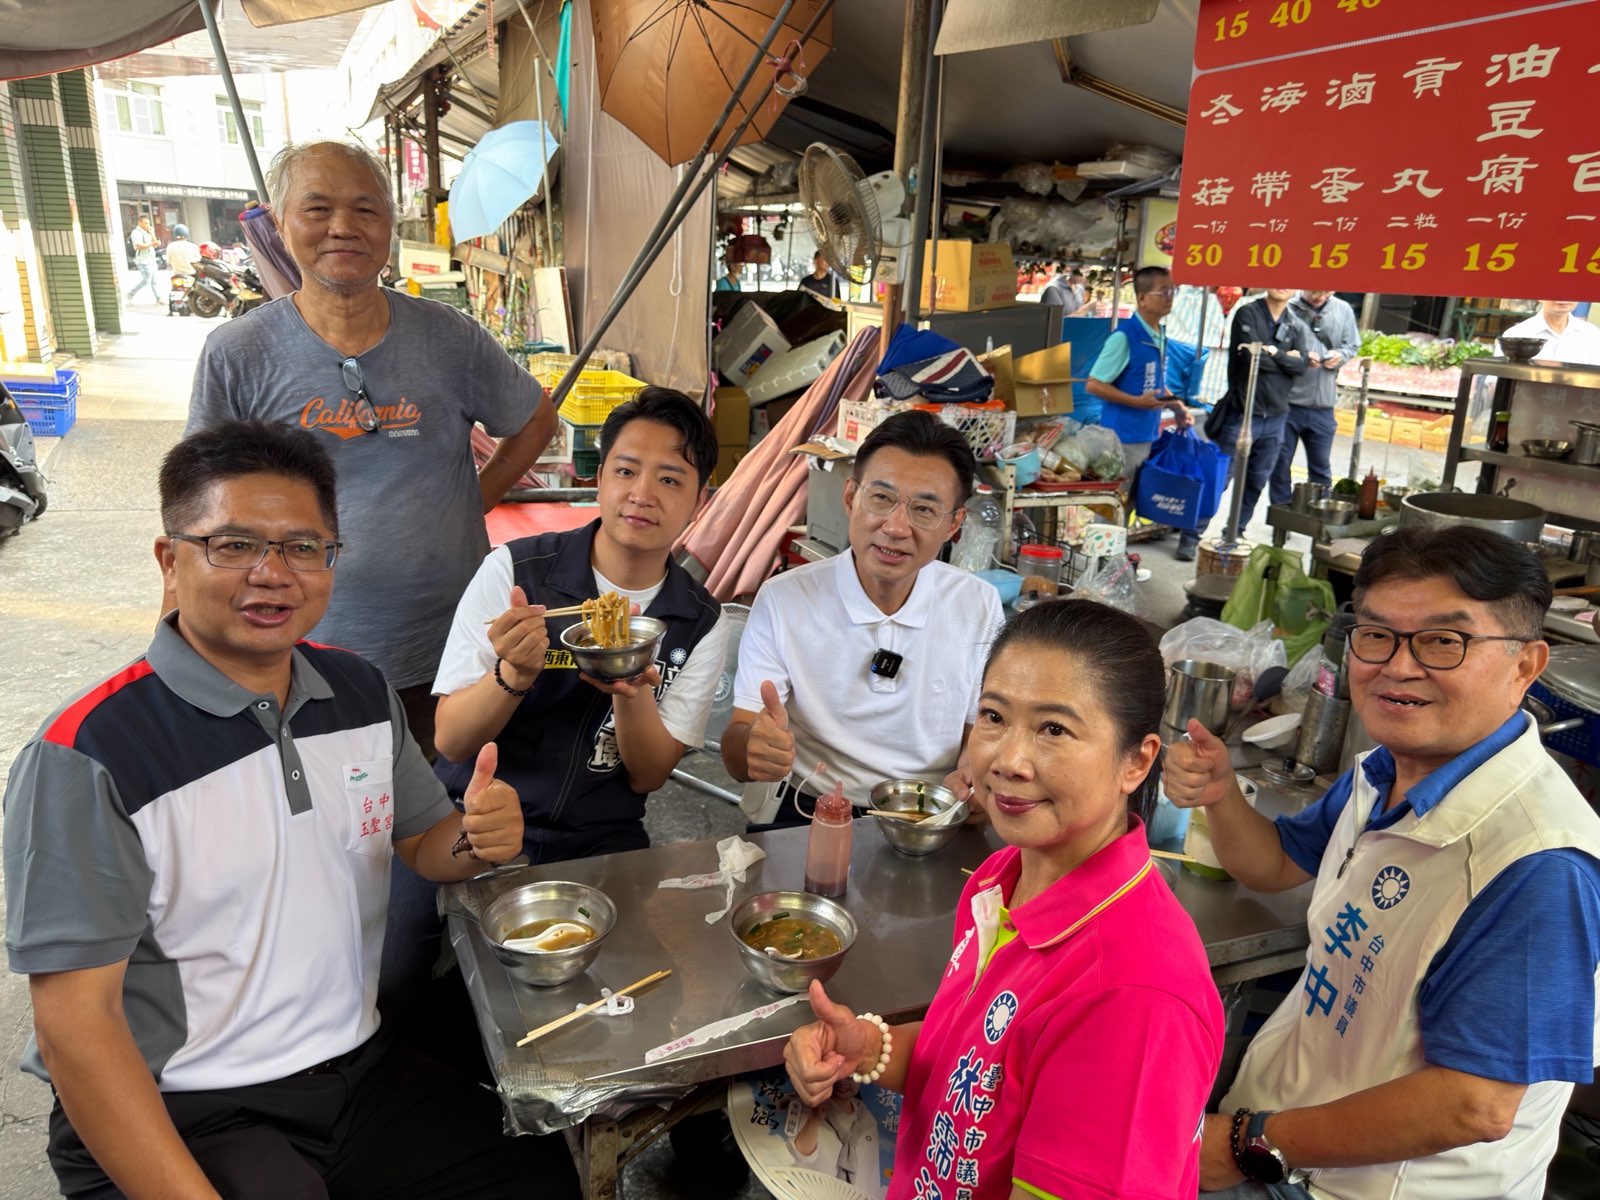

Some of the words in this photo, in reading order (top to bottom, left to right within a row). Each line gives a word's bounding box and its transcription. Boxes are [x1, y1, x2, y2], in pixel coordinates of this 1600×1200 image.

[1214, 10, 1249, 42] 15
[1269, 0, 1312, 28] 40
[1381, 56, 1463, 199] 貢丸
[1466, 43, 1561, 195] 油豆腐
[1191, 93, 1245, 207] 冬菇
[1251, 81, 1308, 208] 海帶
[1310, 72, 1377, 204] 滷蛋
[1193, 220, 1229, 234] 一份
[1249, 218, 1290, 233] 一份
[1313, 216, 1359, 232] 一份
[1386, 212, 1439, 229] 二粒
[1466, 212, 1528, 230] 一份
[1186, 243, 1223, 267] 30
[1248, 243, 1282, 268] 10
[1309, 243, 1351, 269] 15
[1380, 242, 1429, 270] 15
[1463, 242, 1519, 272] 15
[544, 650, 576, 666] 西東
[363, 793, 390, 814] 台中
